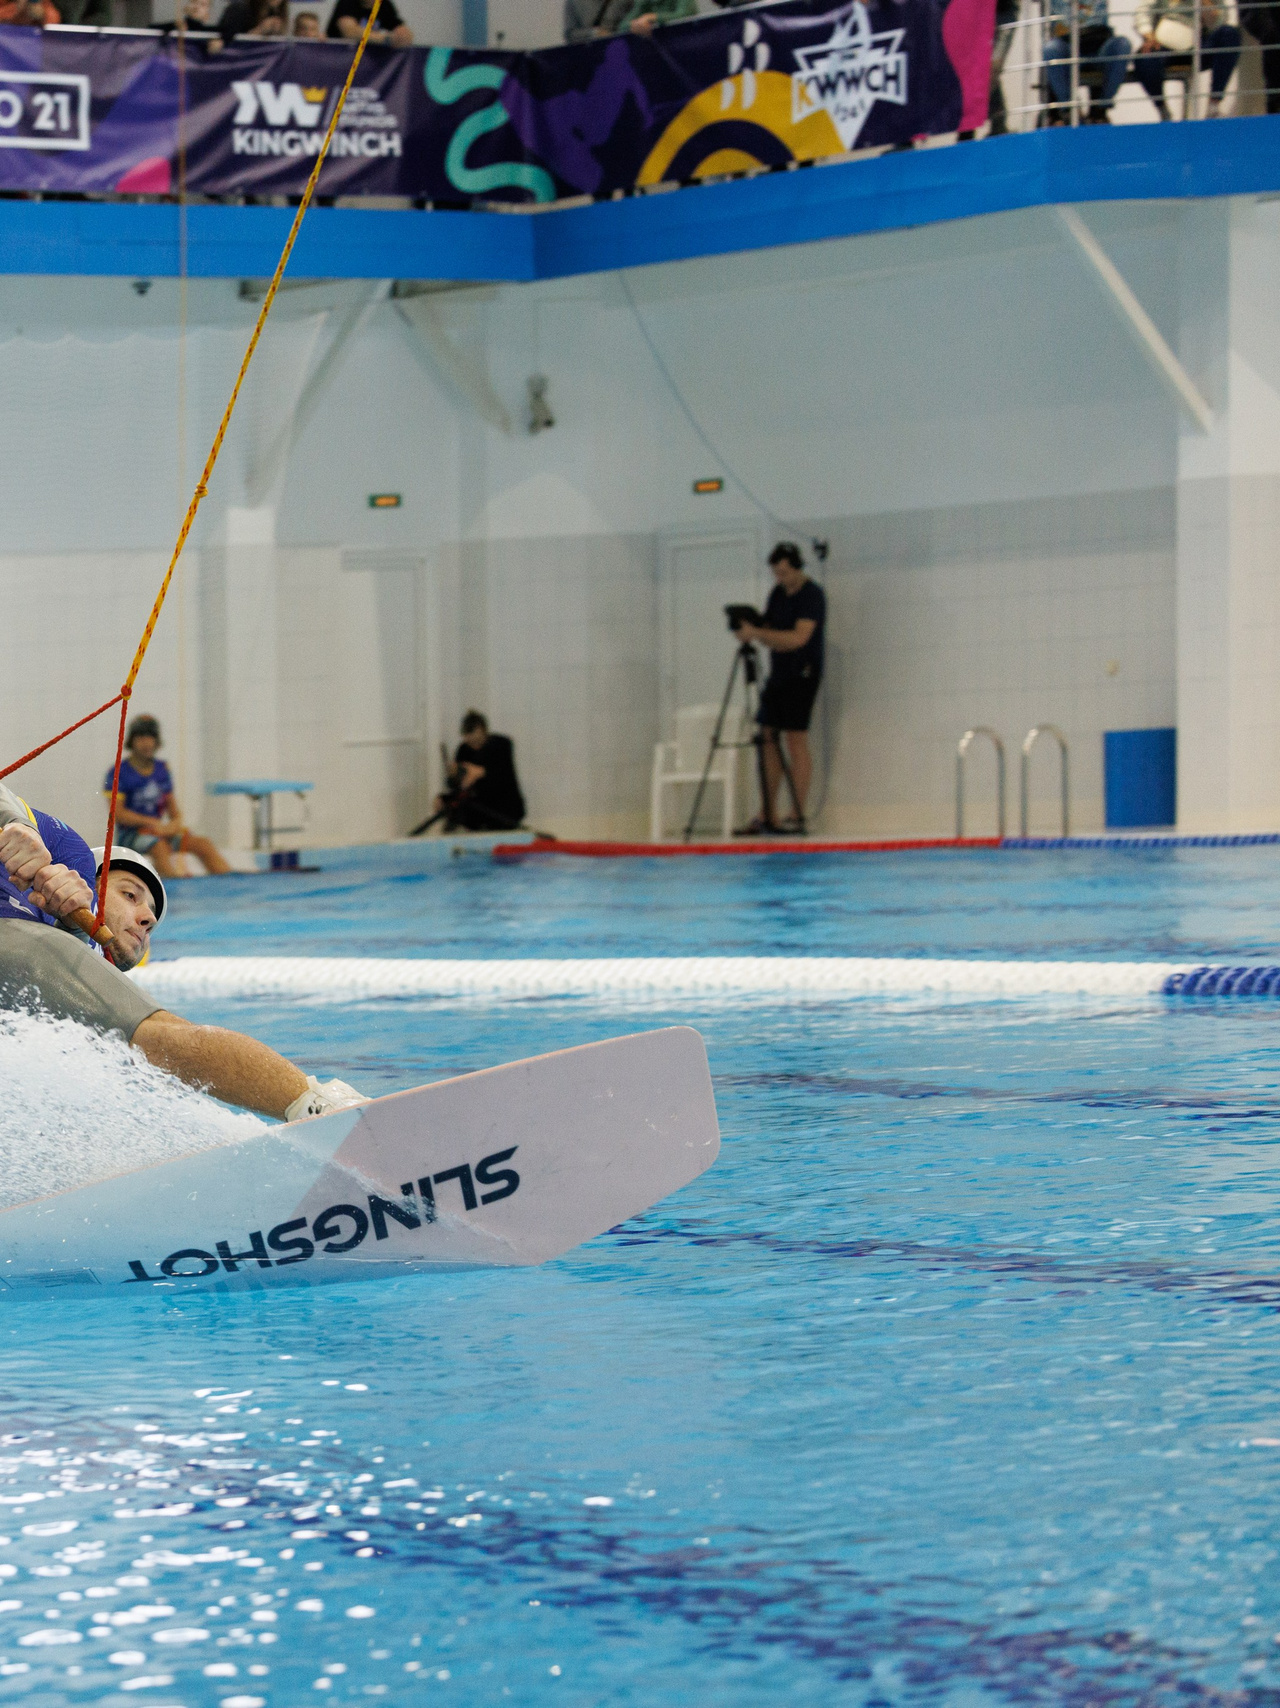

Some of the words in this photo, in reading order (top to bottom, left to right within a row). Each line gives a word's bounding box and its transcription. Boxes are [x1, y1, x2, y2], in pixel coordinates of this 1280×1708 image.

[31, 92, 70, 131] 21
[232, 128, 403, 158] KINGWINCH
[121, 1145, 520, 1284] SLINGSHOT
